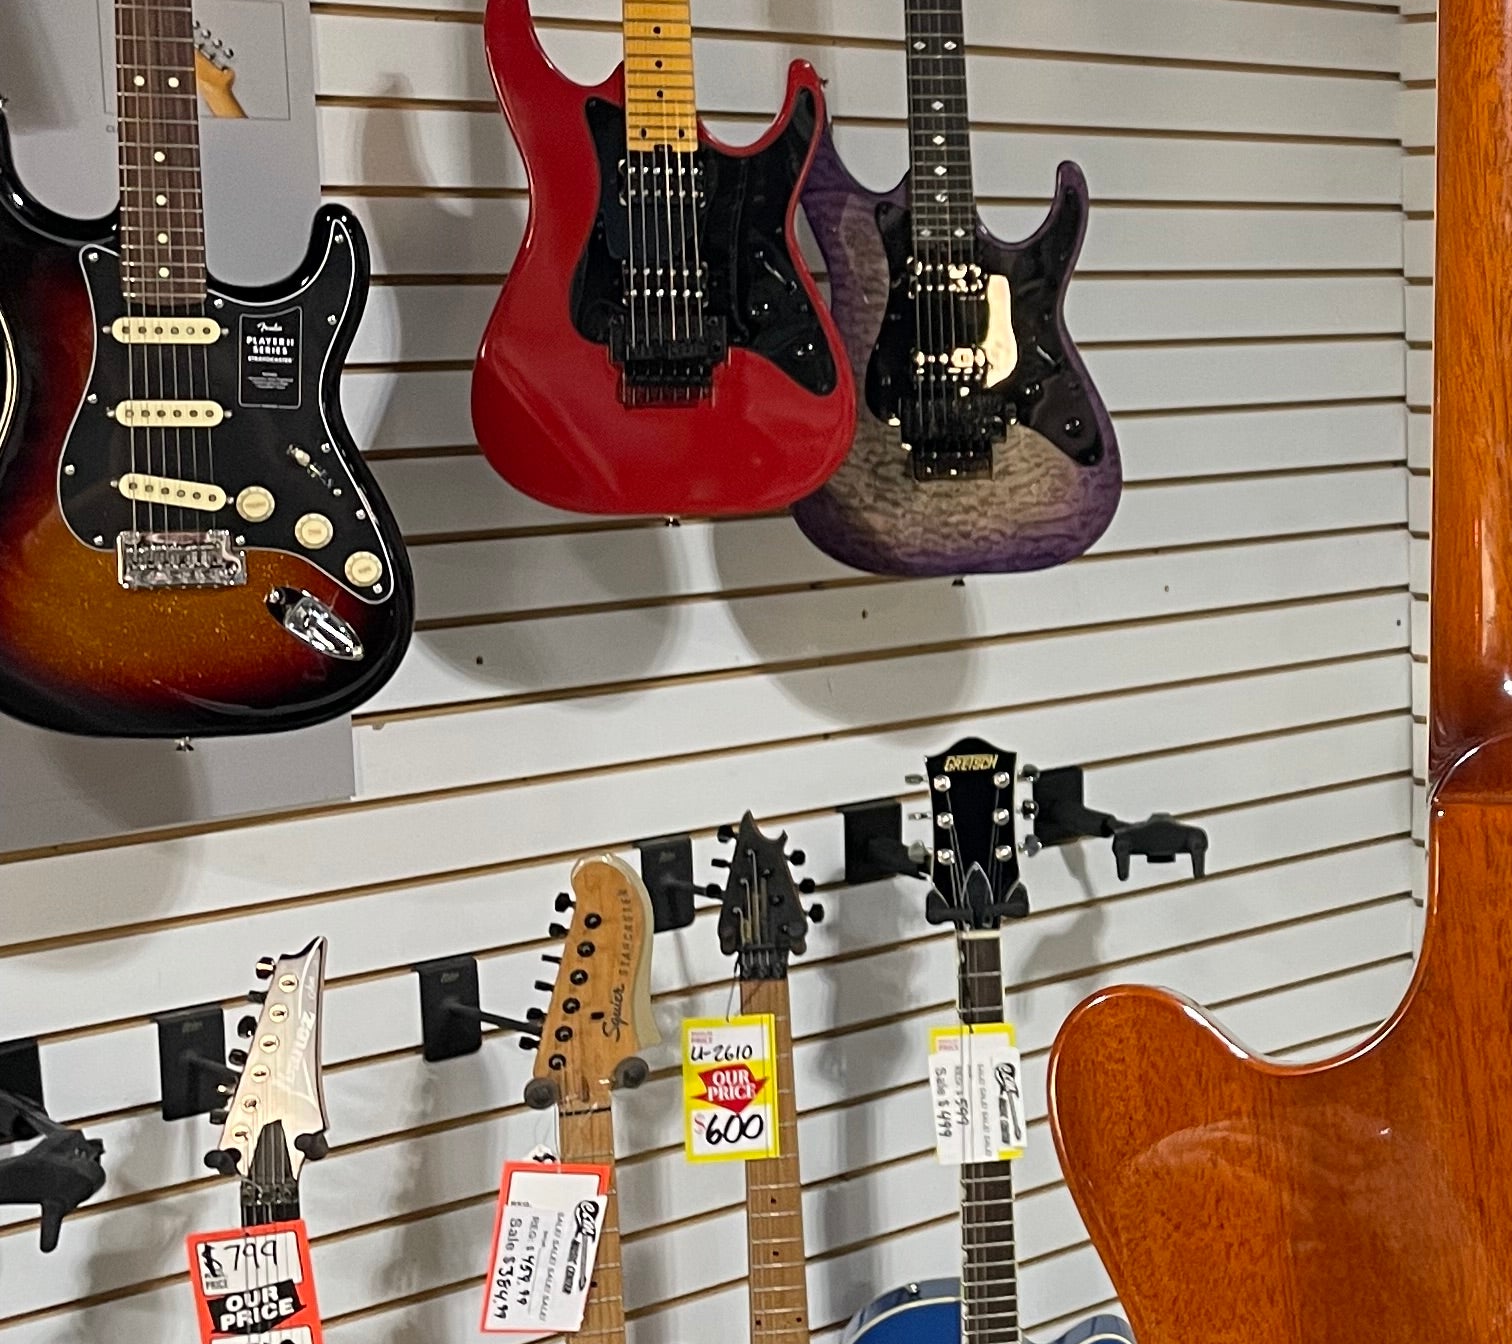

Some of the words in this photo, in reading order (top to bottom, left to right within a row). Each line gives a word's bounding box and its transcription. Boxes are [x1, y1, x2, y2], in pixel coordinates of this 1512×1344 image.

[944, 754, 998, 772] GRETSCH
[602, 984, 629, 1042] Squier
[707, 1083, 757, 1101] PRICE
[712, 1069, 750, 1087] OUR
[694, 1113, 764, 1145] $600
[505, 1218, 522, 1251] Sale
[225, 1285, 279, 1312] OUR
[220, 1297, 295, 1332] PRICE
